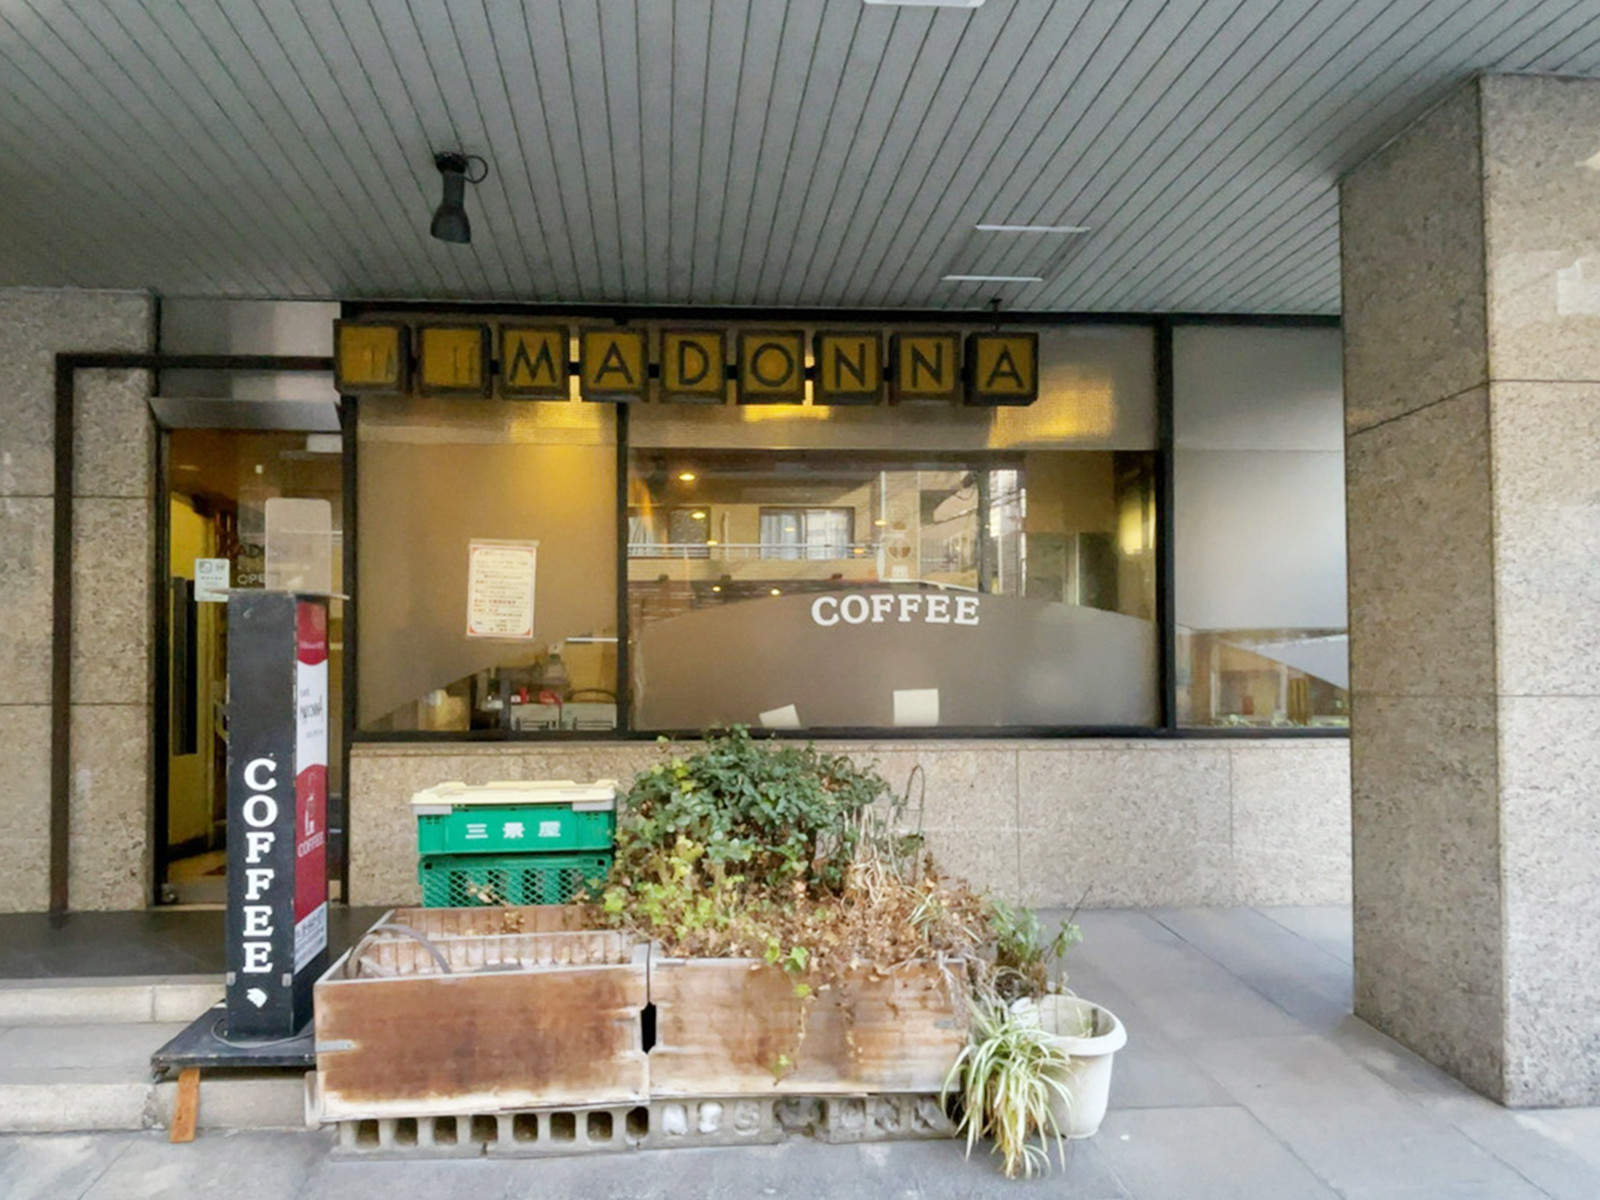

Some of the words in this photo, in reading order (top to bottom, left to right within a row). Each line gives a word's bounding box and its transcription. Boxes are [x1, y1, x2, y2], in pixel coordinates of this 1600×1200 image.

[508, 337, 1025, 389] MADONNA
[811, 594, 980, 627] COFFEE
[243, 758, 278, 973] COFFEE
